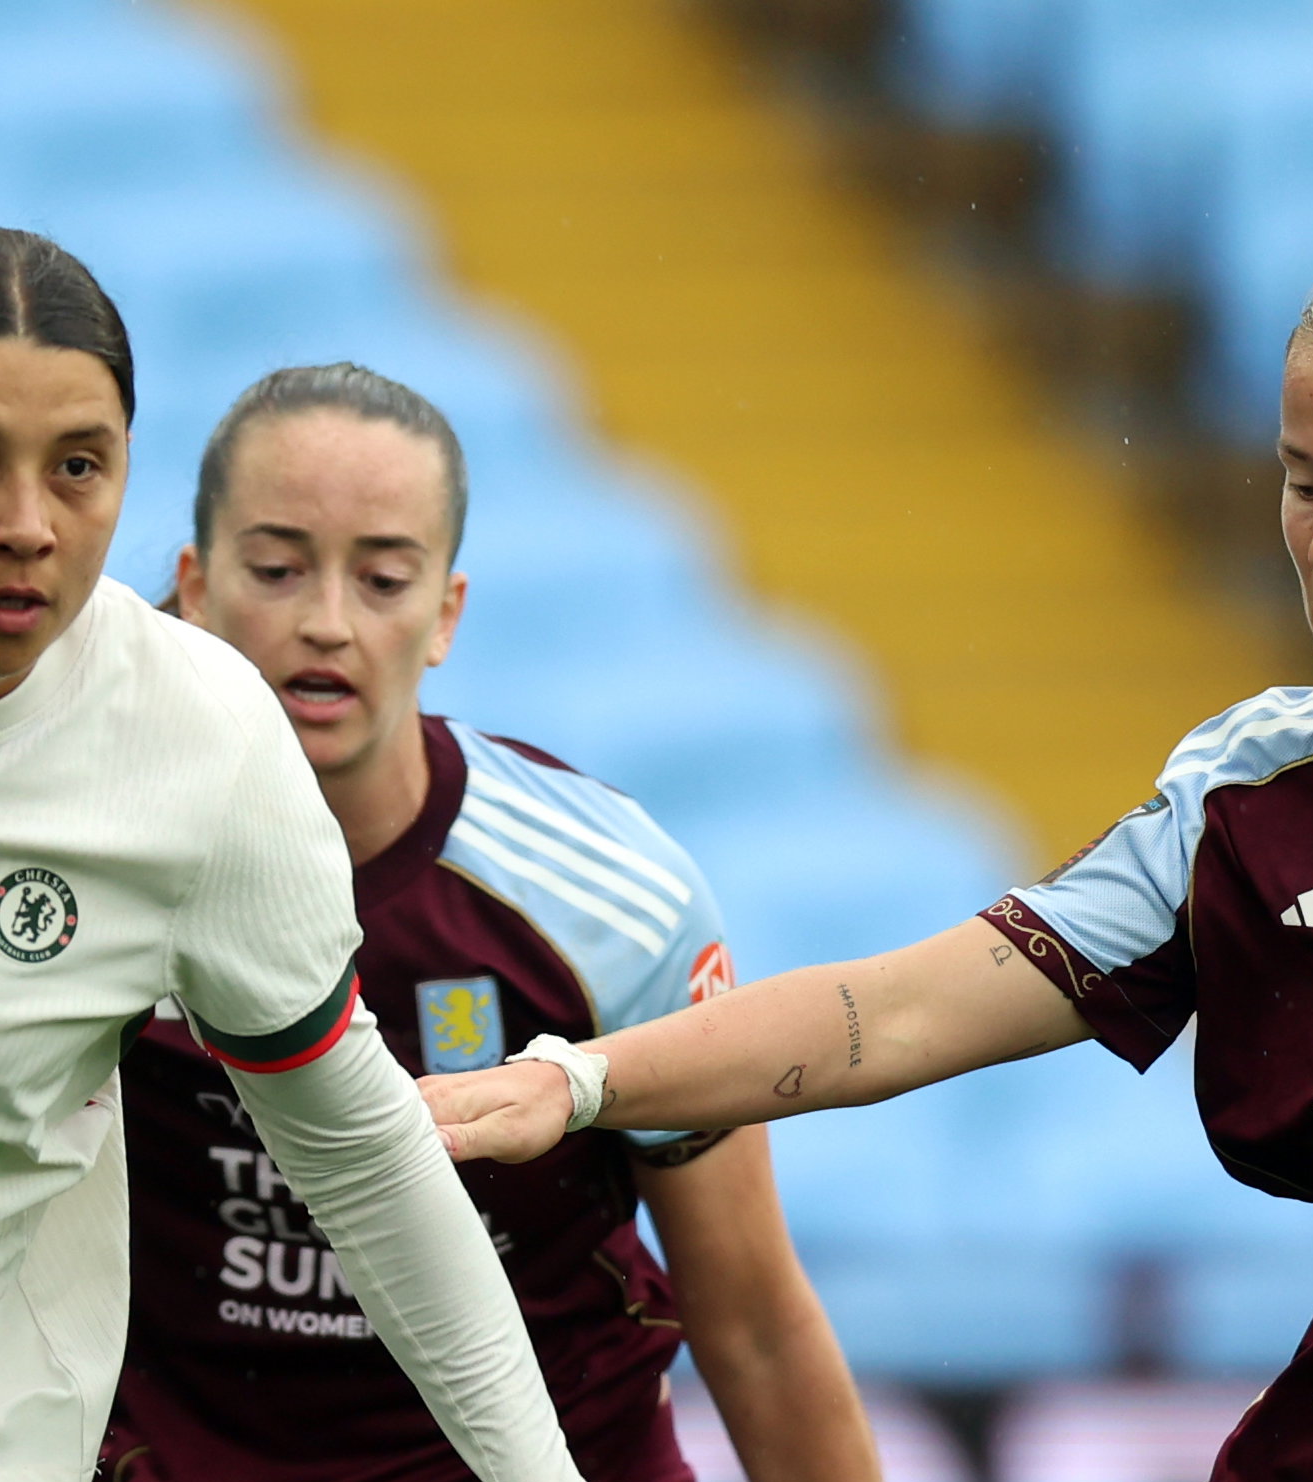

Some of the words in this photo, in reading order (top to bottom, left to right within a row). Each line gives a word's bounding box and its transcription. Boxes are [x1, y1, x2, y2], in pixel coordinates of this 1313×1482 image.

[14, 869, 72, 902] CHELSEA
[208, 1146, 305, 1204] TH
[219, 1235, 356, 1300] SUM
[218, 1299, 263, 1327] ON
